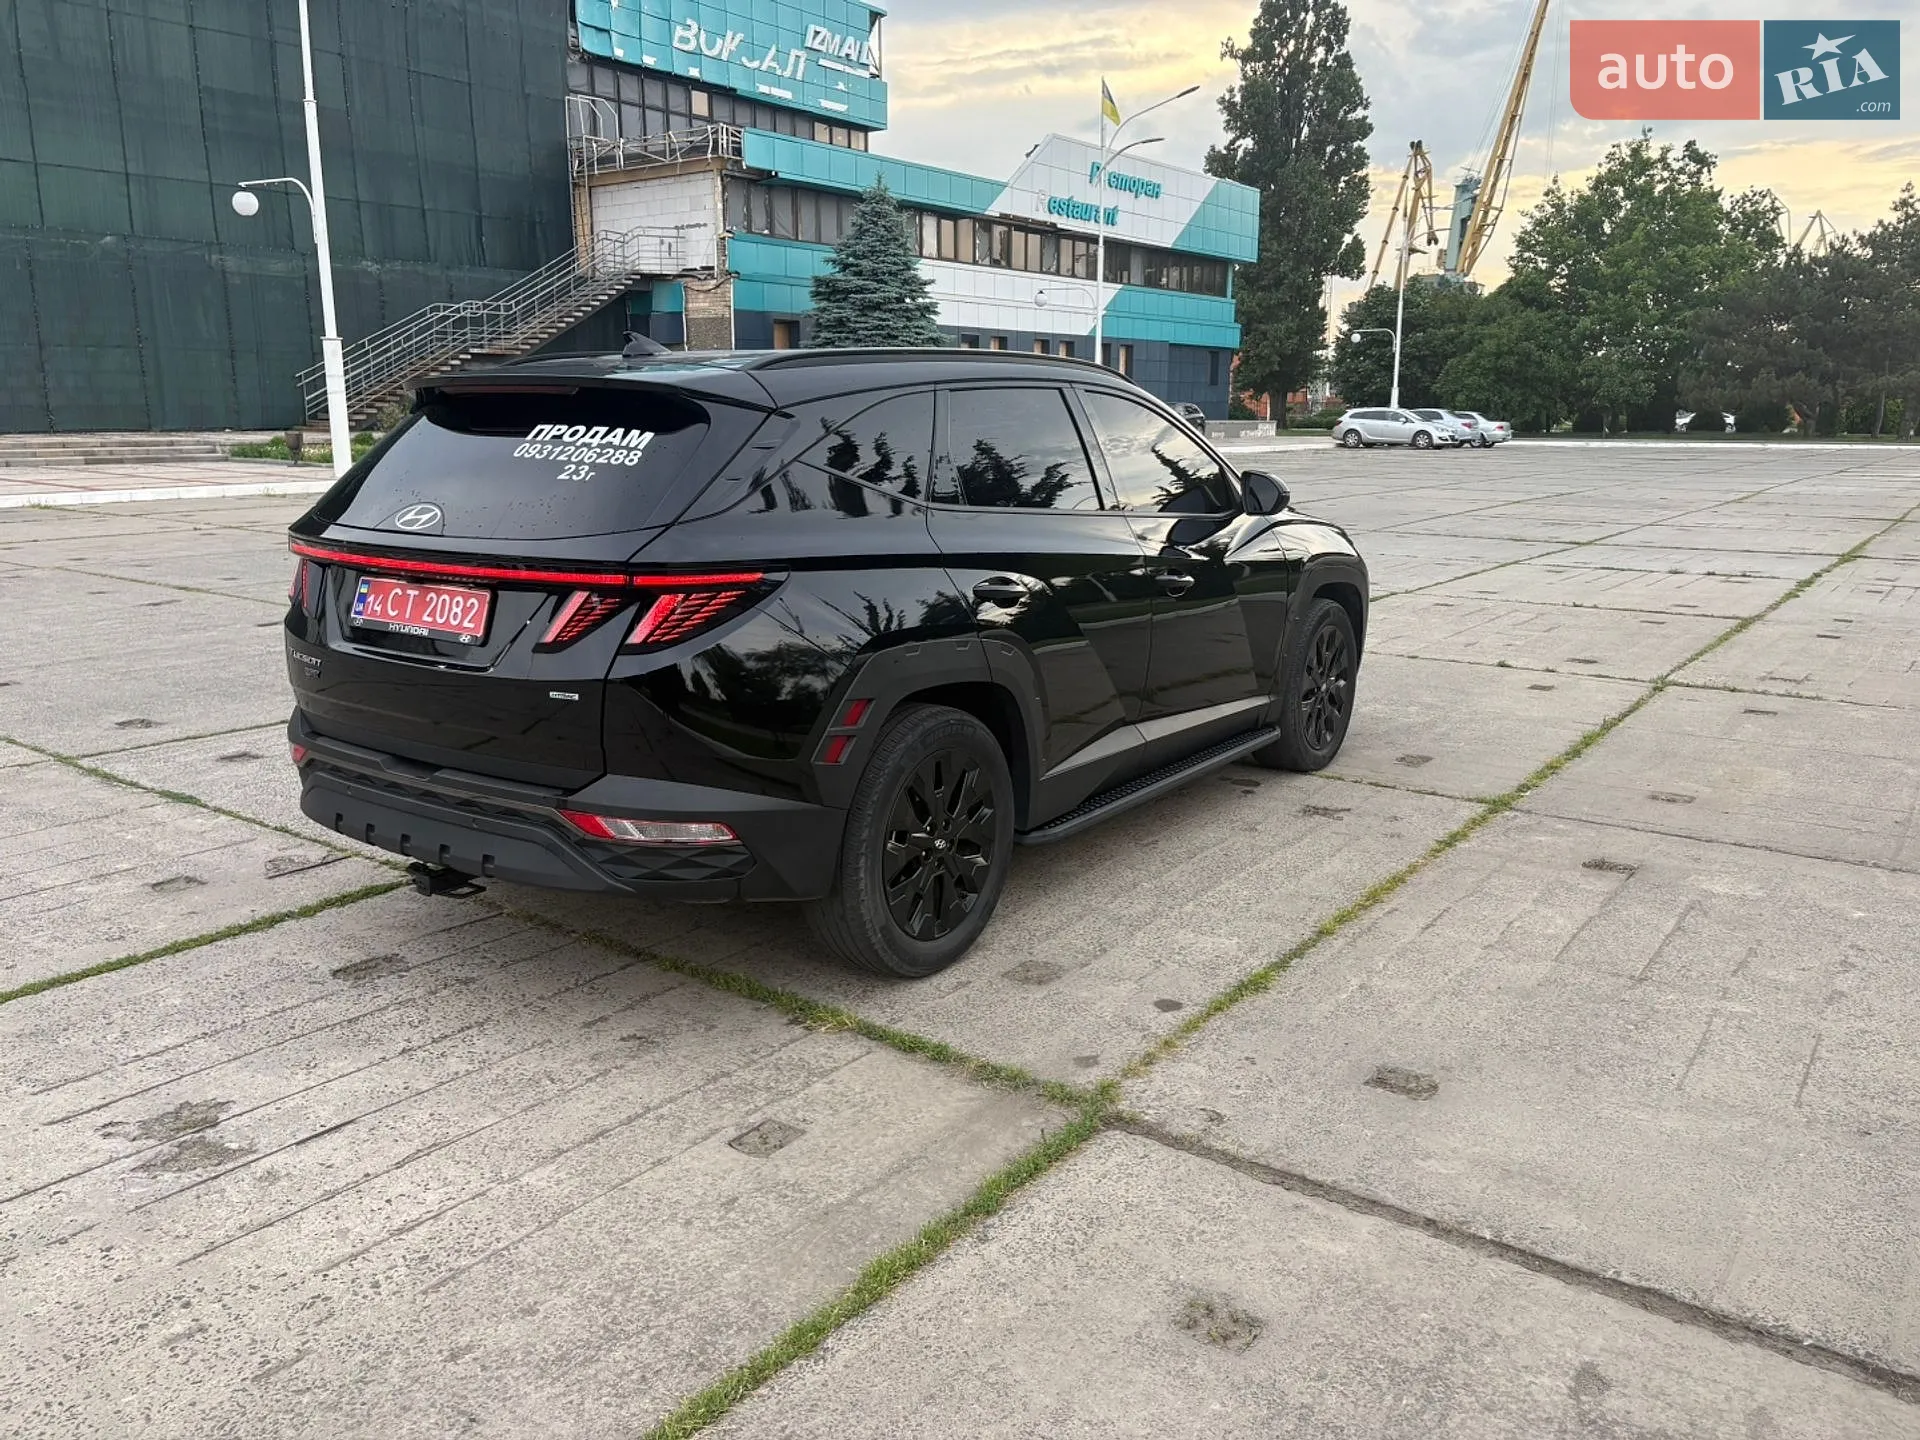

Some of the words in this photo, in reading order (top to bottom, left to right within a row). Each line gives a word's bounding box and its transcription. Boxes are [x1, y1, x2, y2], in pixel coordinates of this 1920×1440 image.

[525, 424, 655, 449] ПРОДАМ
[513, 443, 642, 466] 0931206288
[366, 593, 384, 617] 14
[387, 588, 419, 619] CT
[422, 592, 479, 628] 2082
[388, 622, 430, 636] HYUNDAI
